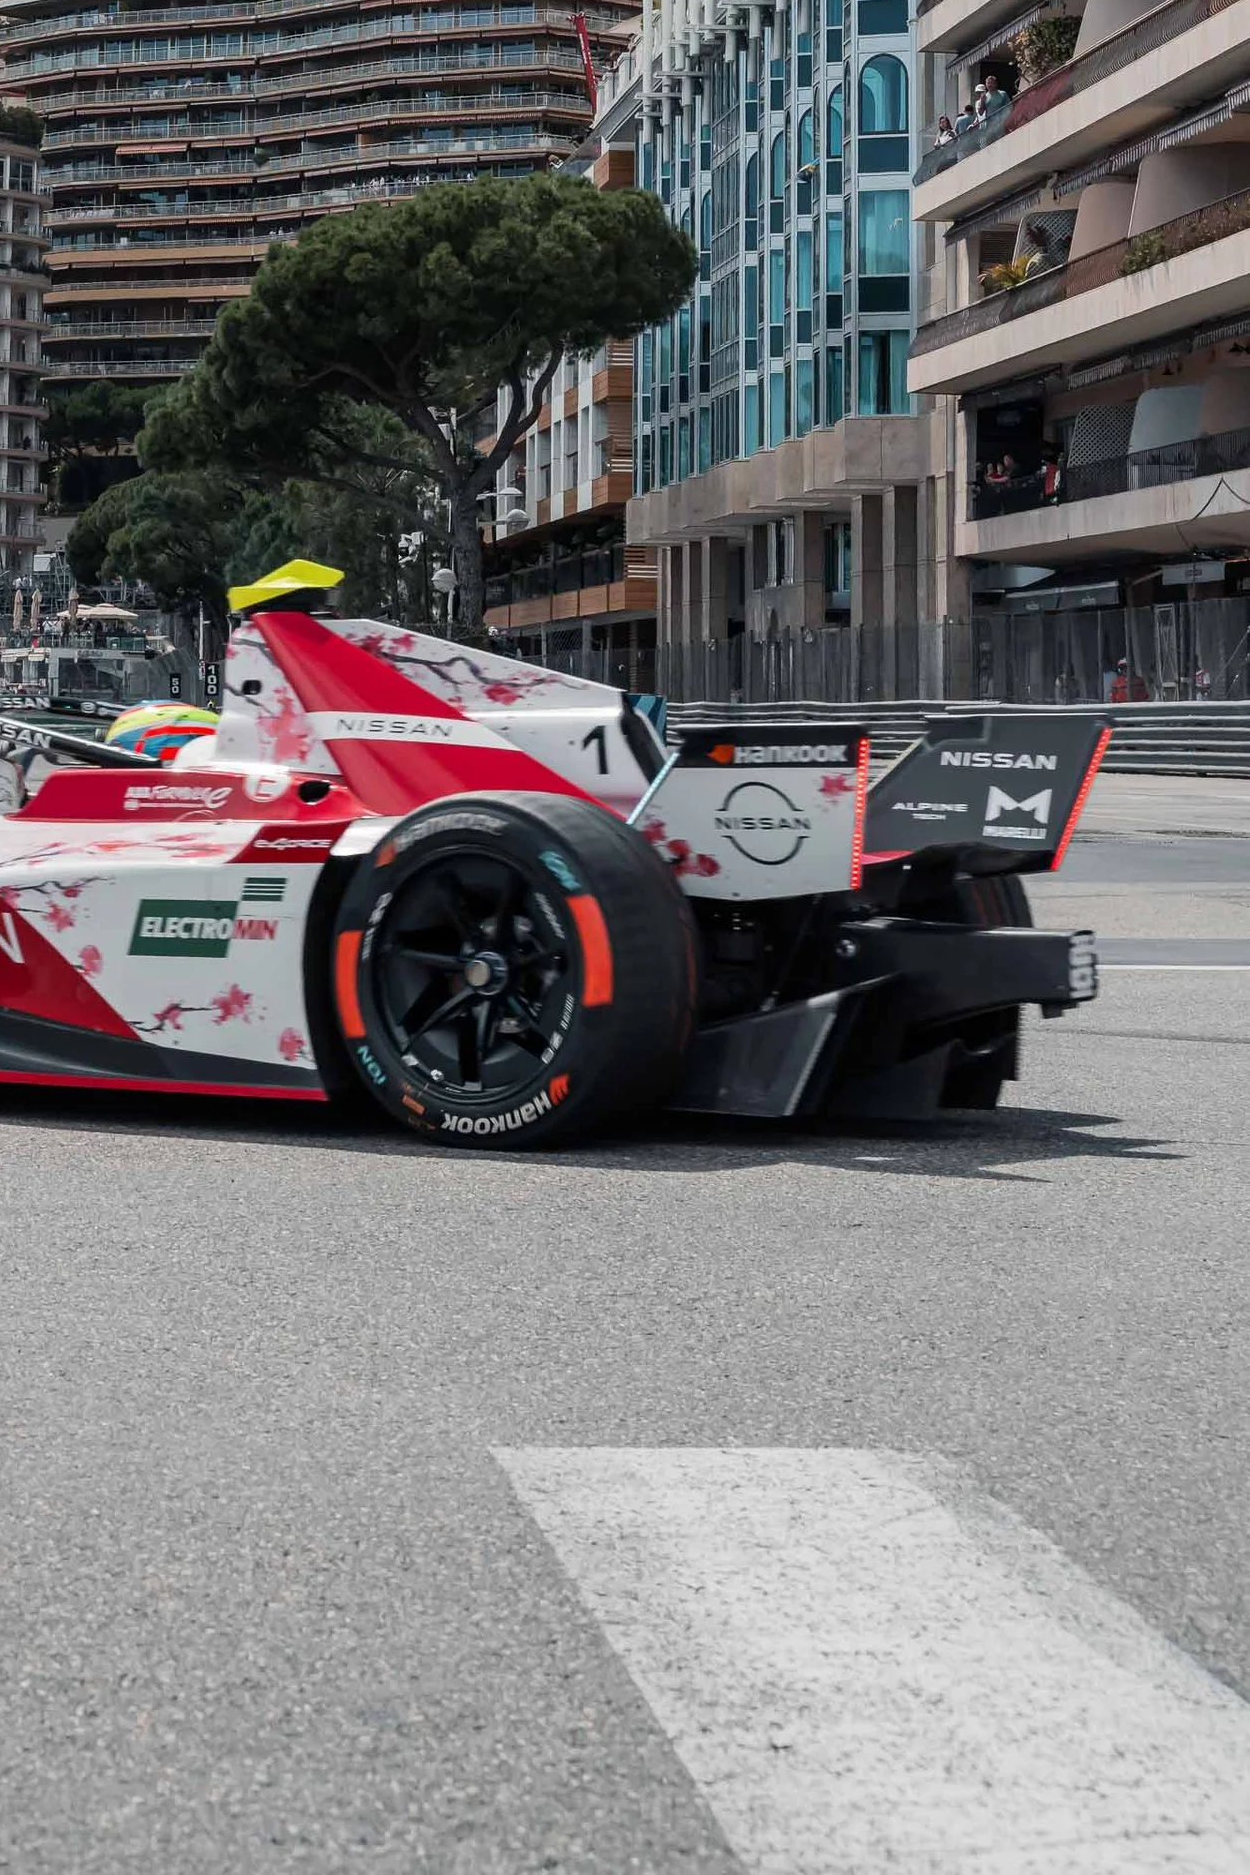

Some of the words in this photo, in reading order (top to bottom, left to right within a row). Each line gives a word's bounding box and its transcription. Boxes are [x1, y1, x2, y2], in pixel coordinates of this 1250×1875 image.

[171, 677, 180, 694] 50
[207, 664, 217, 695] 100
[337, 717, 452, 737] NISSAN
[581, 724, 610, 776] 1
[940, 750, 1058, 771] NISSAN
[891, 801, 970, 813] ALPINE
[714, 816, 812, 831] NISSAN
